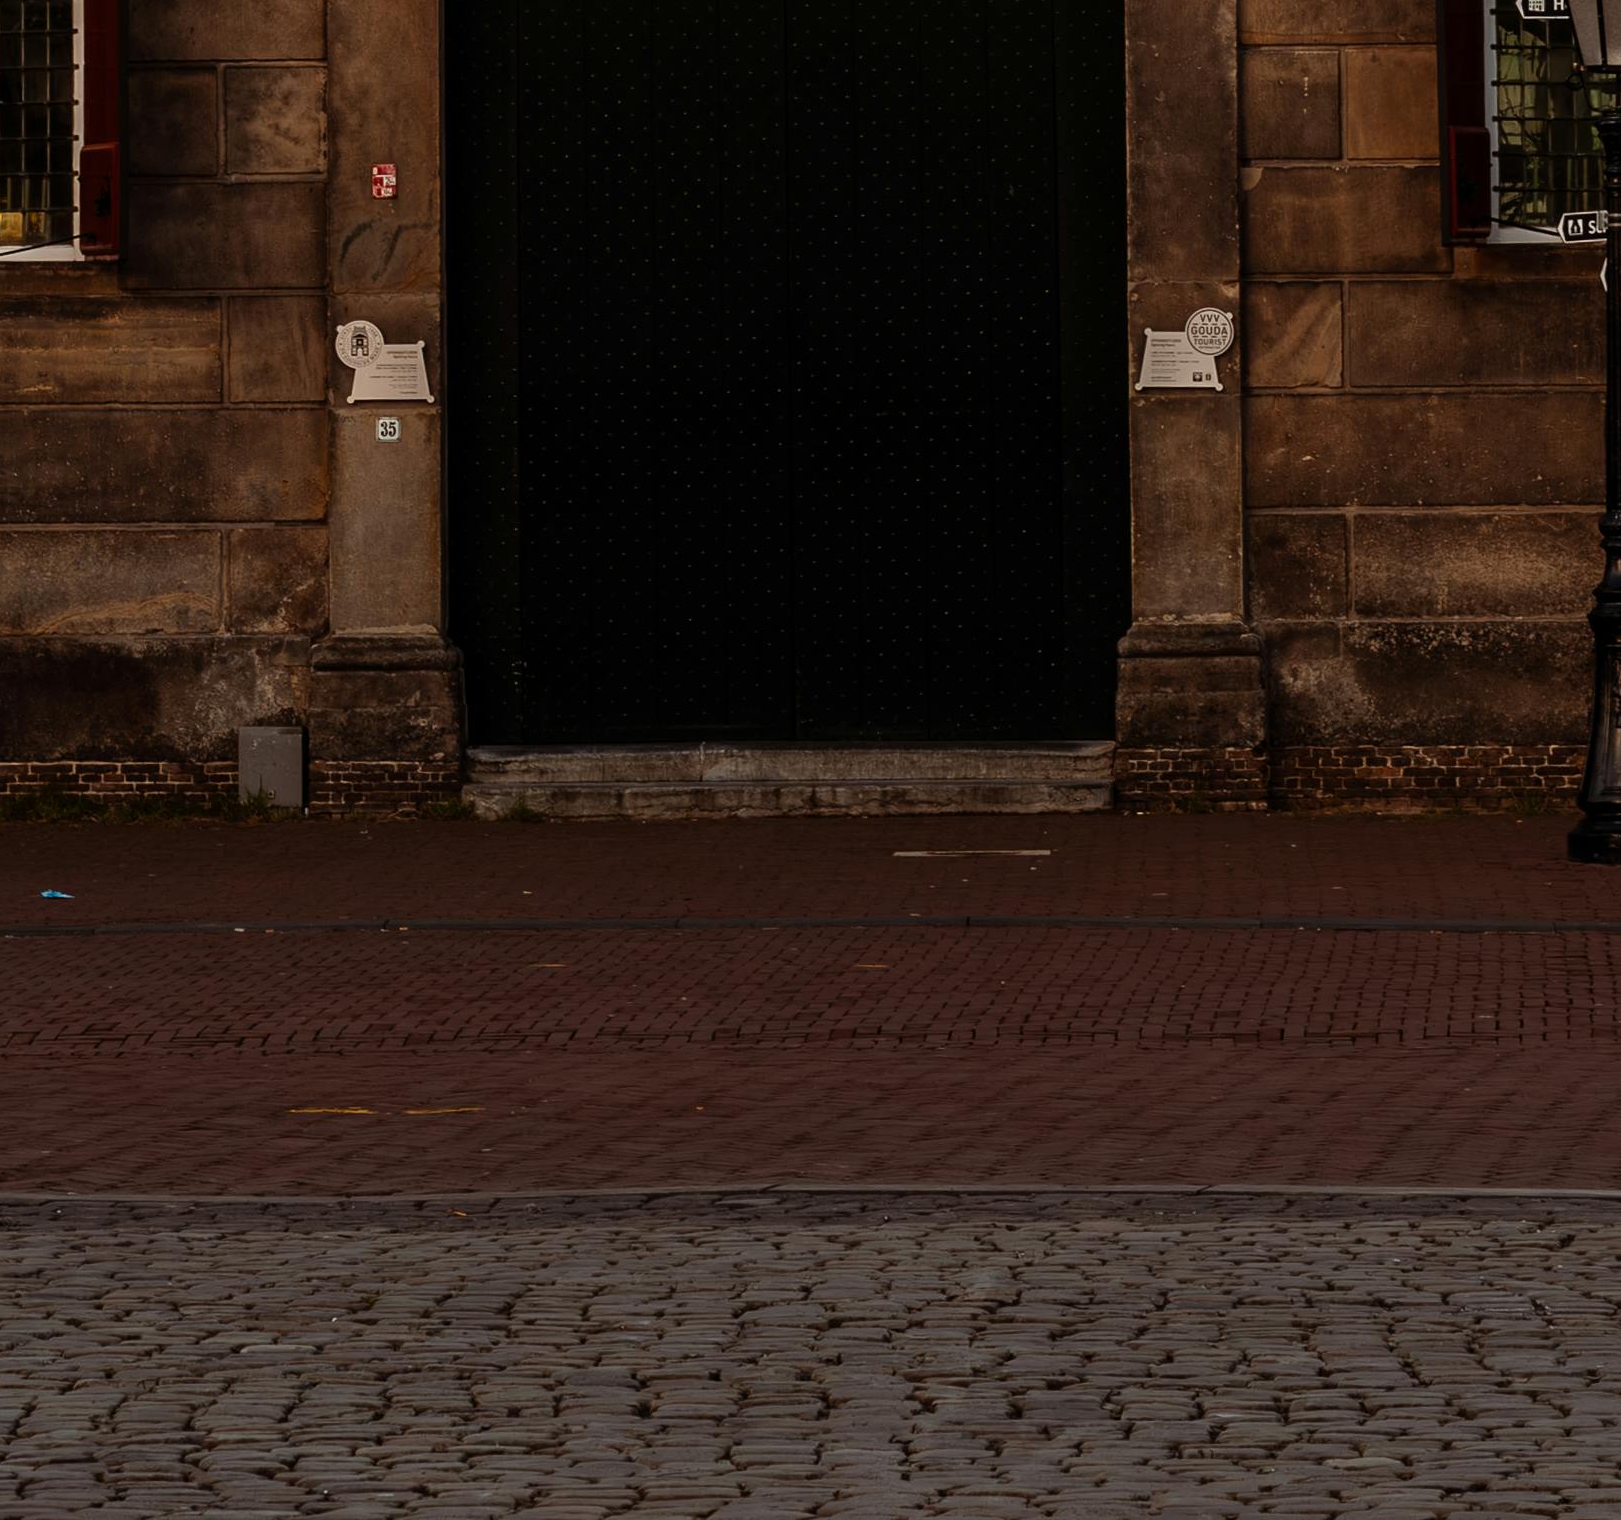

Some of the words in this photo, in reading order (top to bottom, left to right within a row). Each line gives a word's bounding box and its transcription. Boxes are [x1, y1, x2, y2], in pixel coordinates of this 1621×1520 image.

[1199, 313, 1221, 322] VVV
[1190, 325, 1228, 336] GOUDA
[1193, 338, 1227, 346] TOURIST
[380, 421, 397, 438] 35
